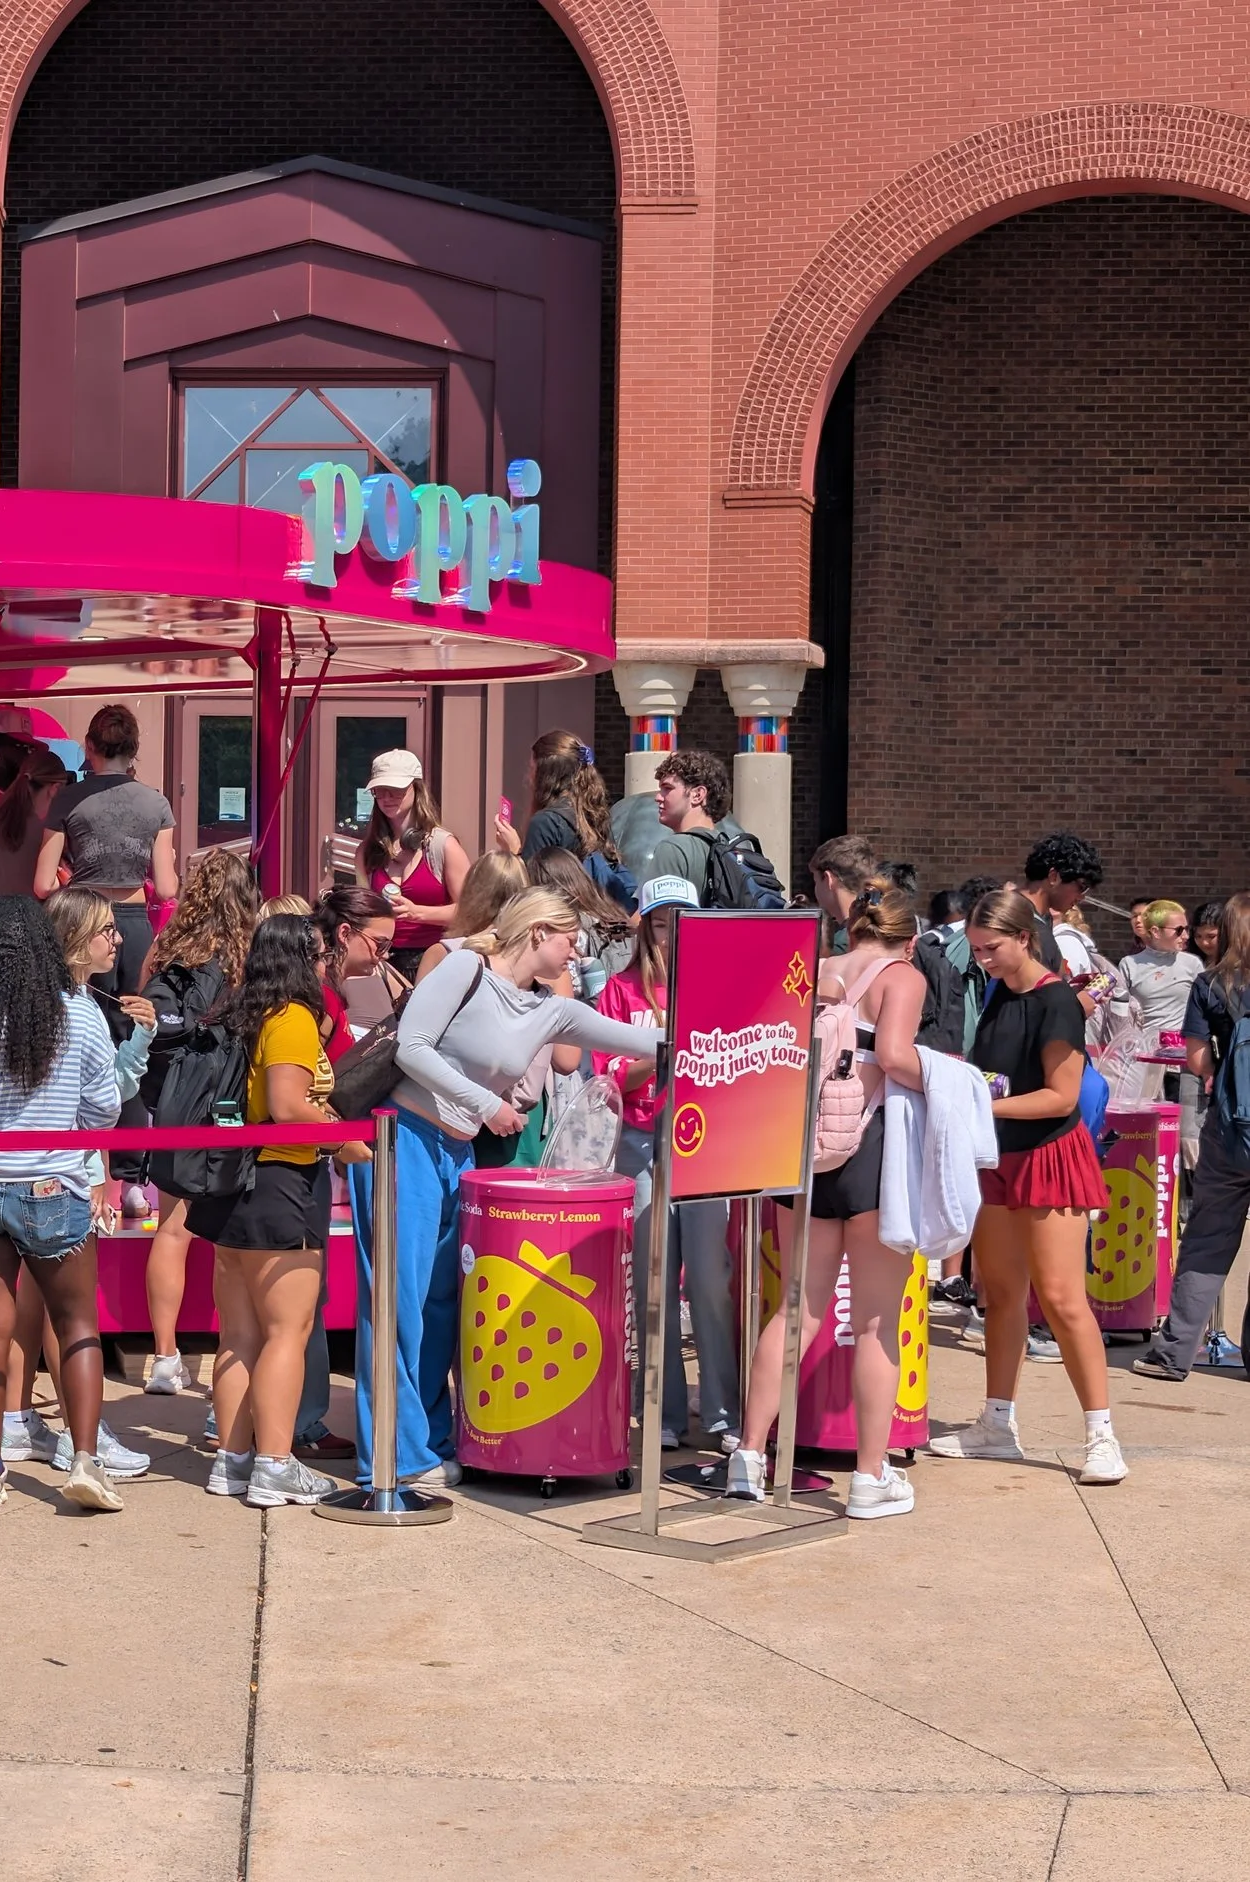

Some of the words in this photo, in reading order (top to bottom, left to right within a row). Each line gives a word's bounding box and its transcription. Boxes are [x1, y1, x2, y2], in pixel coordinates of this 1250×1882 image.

[299, 459, 541, 612] poppi
[657, 881, 685, 890] poppi
[692, 1027, 762, 1053] welcome
[765, 1028, 776, 1039] to
[778, 1025, 795, 1040] the
[676, 1054, 725, 1083] poppi
[727, 1048, 768, 1080] juicy
[771, 1044, 807, 1066] tour
[1120, 1131, 1151, 1141] rawberry
[1157, 1154, 1169, 1239] poppi
[465, 1202, 483, 1216] Soda
[488, 1206, 558, 1225] Strawberry
[559, 1210, 601, 1223] Lemon
[480, 1435, 502, 1445] Better
